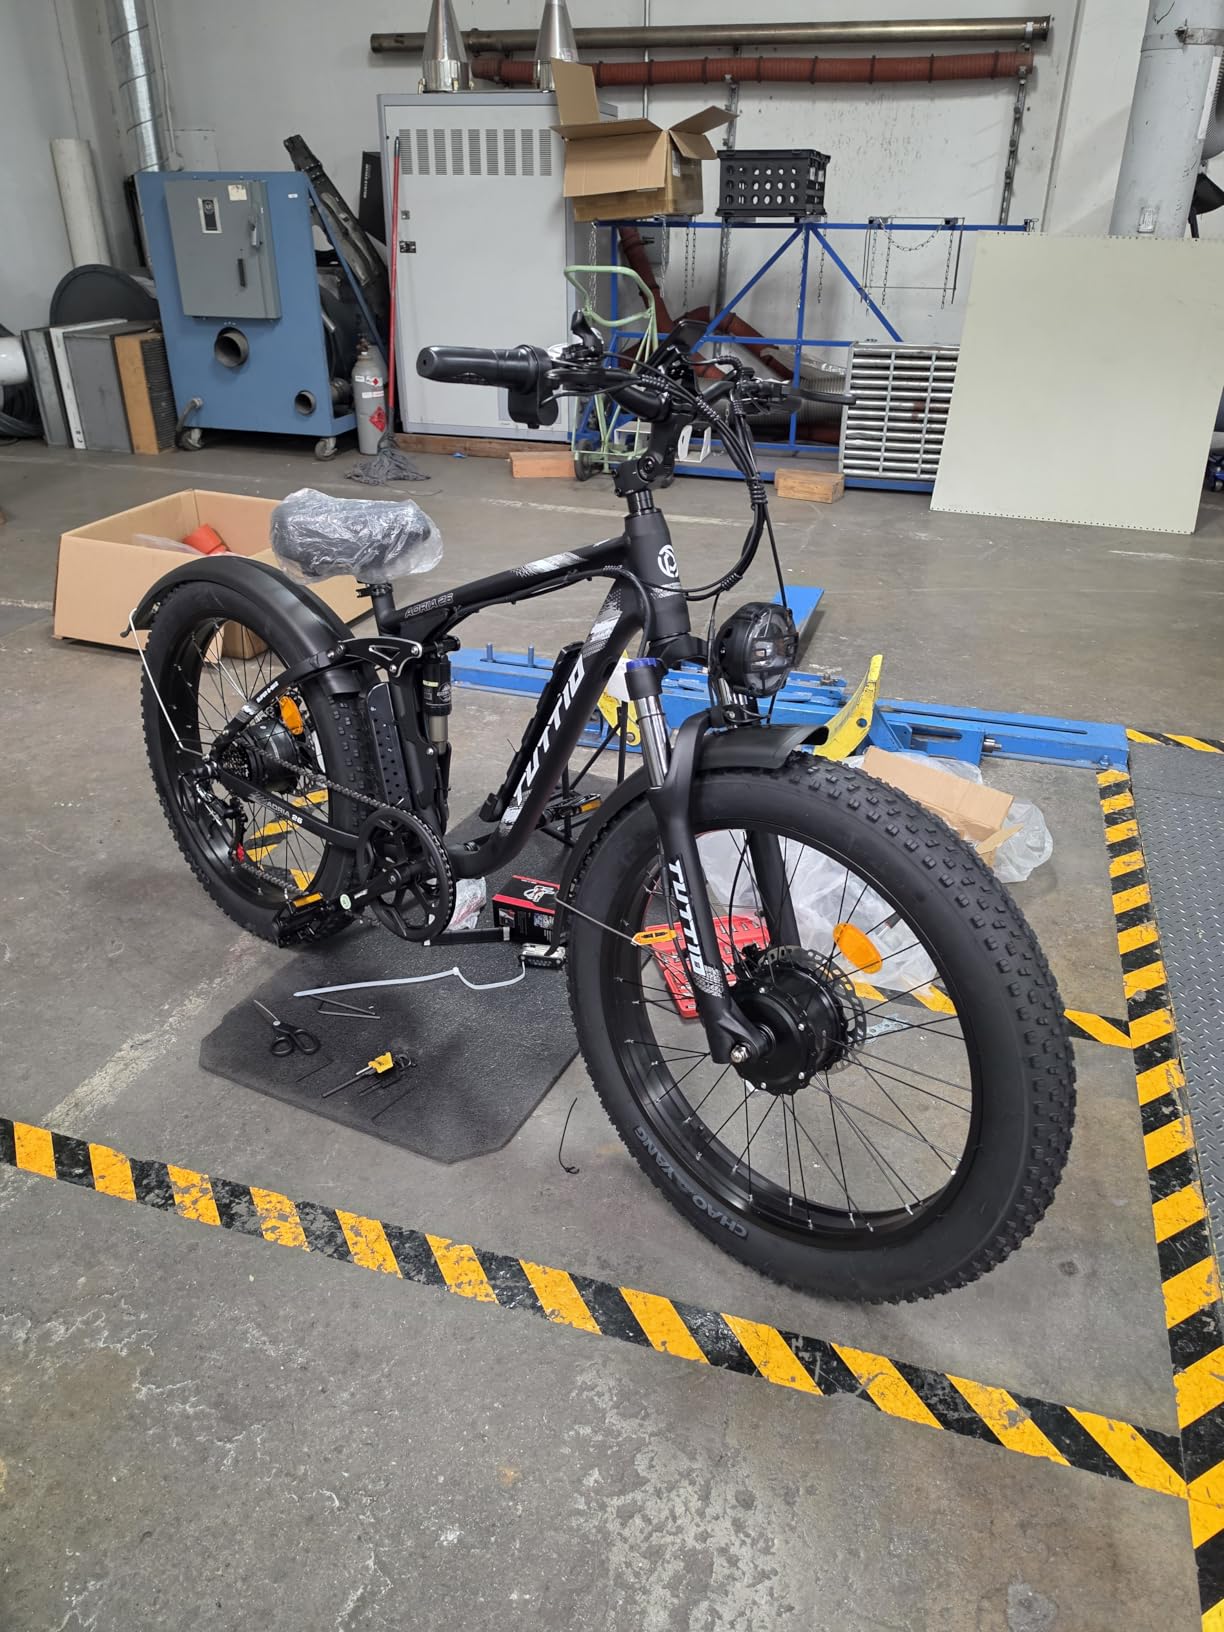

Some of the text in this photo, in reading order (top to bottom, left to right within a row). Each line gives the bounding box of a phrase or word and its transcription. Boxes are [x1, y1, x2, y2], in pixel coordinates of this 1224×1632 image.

[404, 599, 438, 618] ADRIA
[514, 654, 585, 806] TUTTIO
[266, 801, 303, 825] ADRIA 26
[668, 860, 705, 976] TUTTIO
